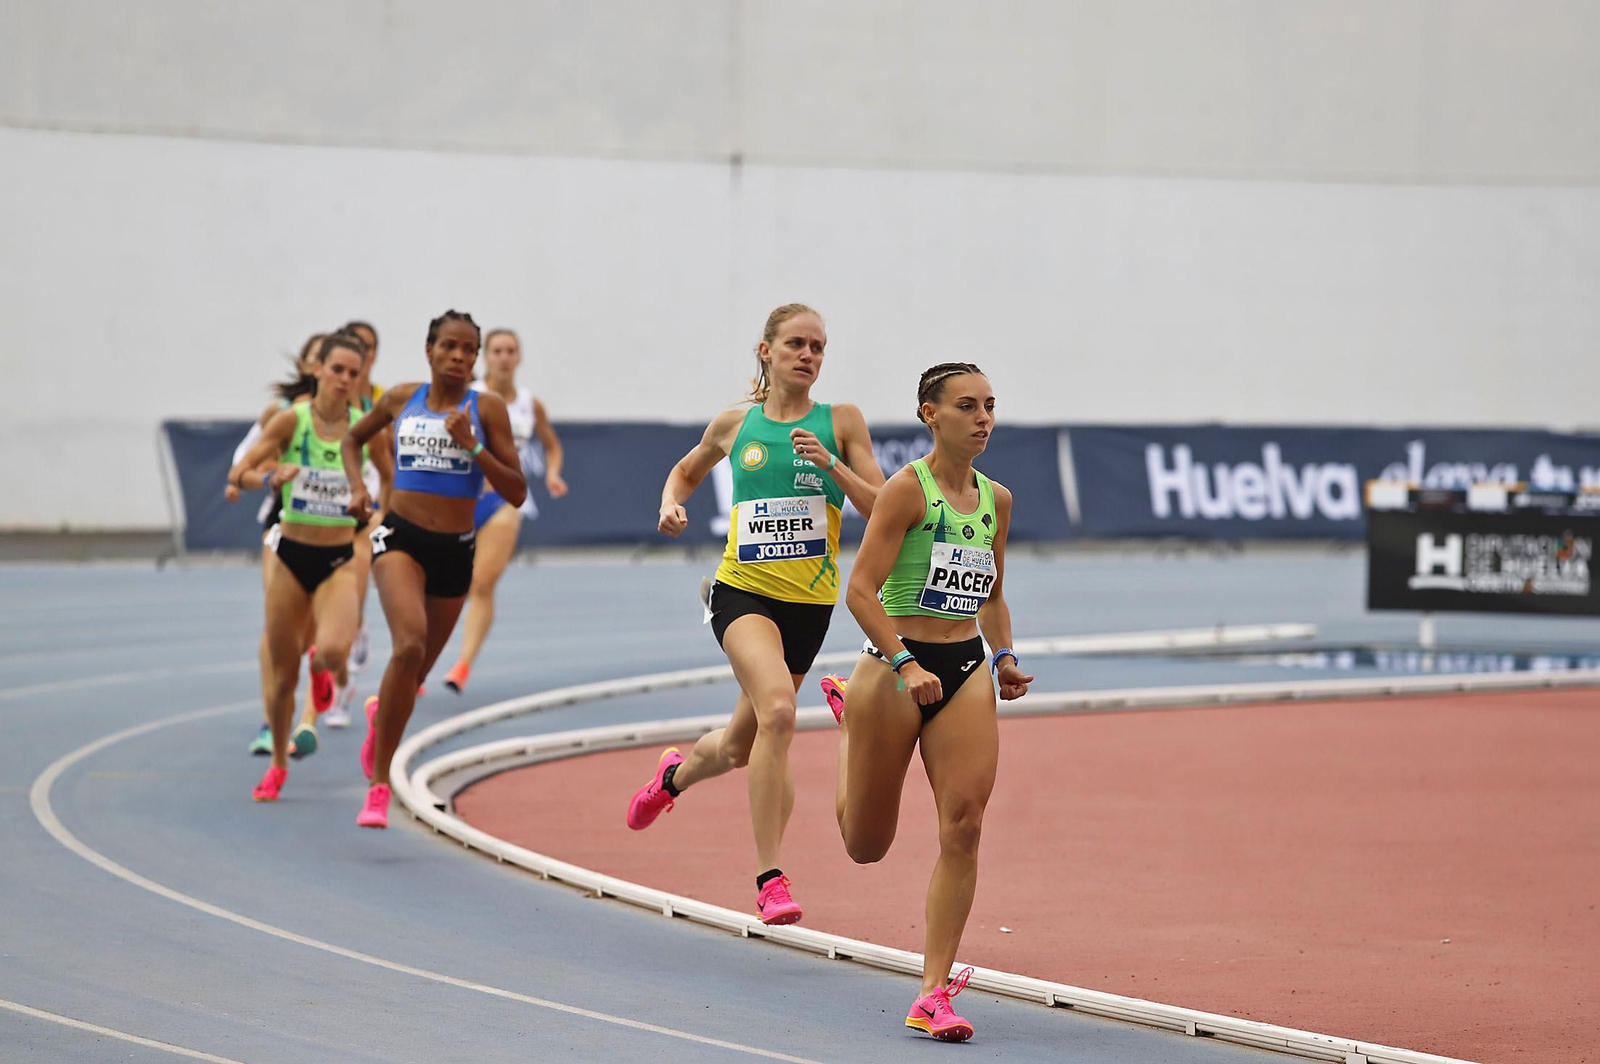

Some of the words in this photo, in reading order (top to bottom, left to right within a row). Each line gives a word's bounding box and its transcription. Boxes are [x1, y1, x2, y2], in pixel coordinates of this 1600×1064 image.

[400, 435, 463, 450] ESCOBA
[1145, 442, 1361, 520] Huelva
[748, 518, 814, 534] WEBER
[773, 531, 795, 541] 113
[756, 543, 808, 560] Joma
[972, 557, 992, 566] HUELVA
[931, 567, 994, 593] PACER
[941, 595, 979, 611] Joma
